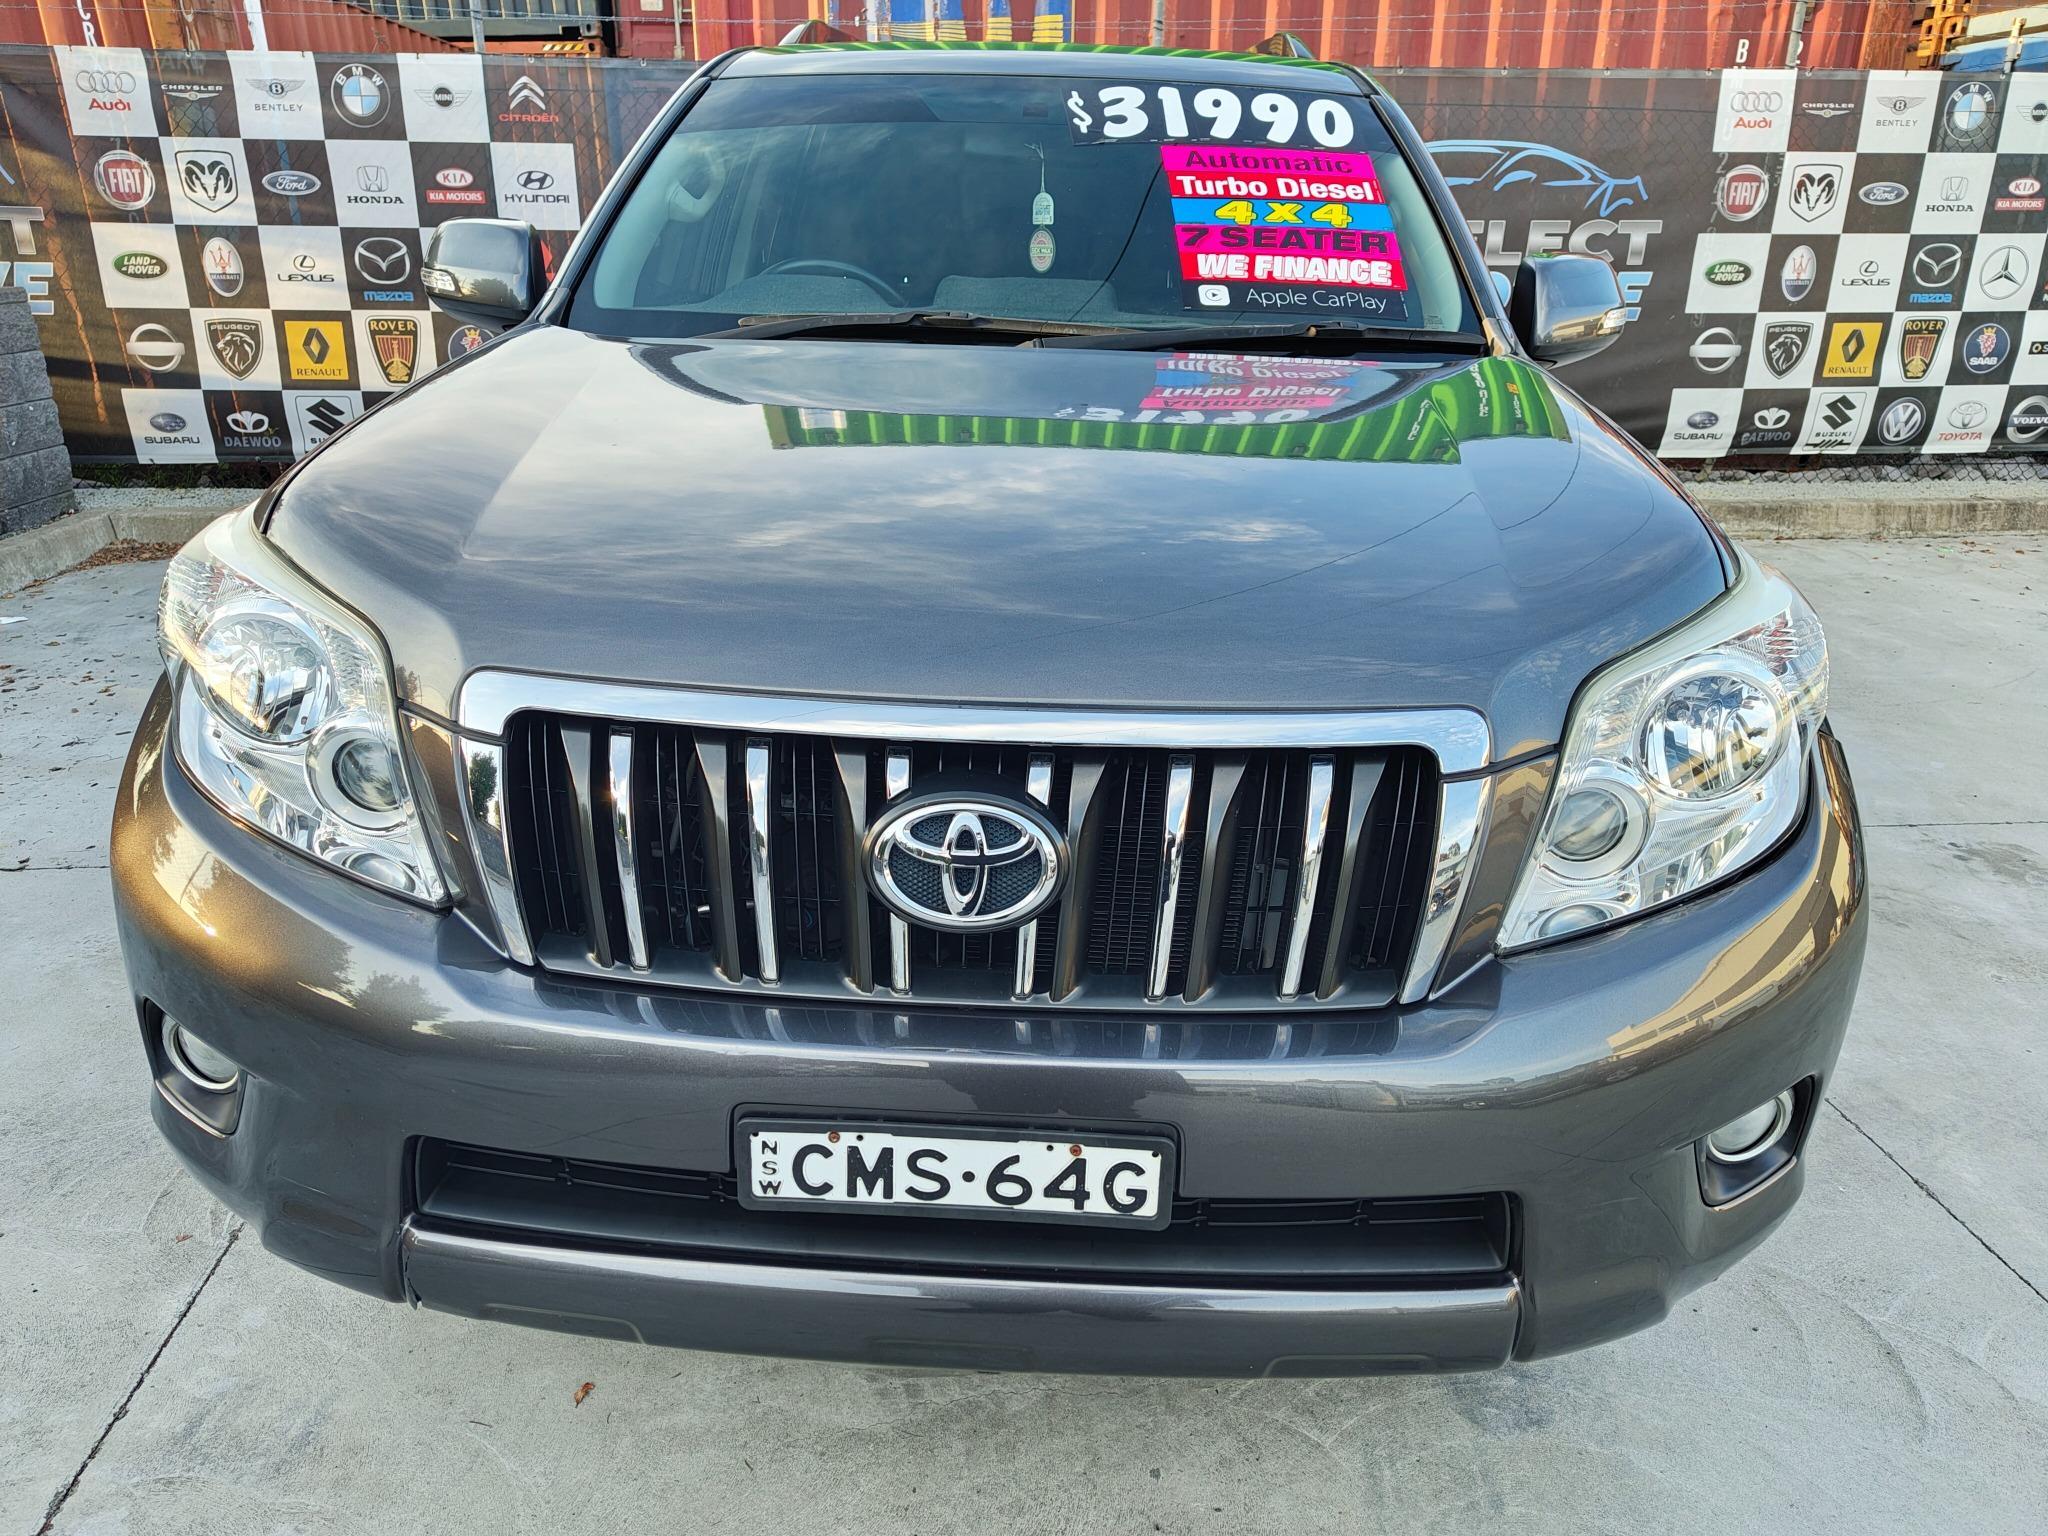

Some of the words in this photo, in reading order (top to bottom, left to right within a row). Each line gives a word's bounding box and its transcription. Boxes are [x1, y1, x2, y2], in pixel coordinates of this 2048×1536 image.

[335, 65, 385, 88] BMW
[1952, 83, 1993, 102] BMW
[88, 98, 131, 111] Audi
[254, 103, 304, 112] BENTLEY
[1066, 85, 1355, 148] $31990
[1733, 116, 1772, 129] Audi
[1875, 119, 1918, 127] BENTLEY
[1185, 151, 1353, 173] Automatic
[108, 168, 141, 193] FIAT
[442, 172, 470, 184] KIA
[275, 178, 307, 191] Ford
[1176, 176, 1268, 197] Turbo
[1278, 178, 1374, 200] Diesel
[2014, 182, 2036, 192] KIA
[429, 192, 447, 201] KIA
[447, 192, 482, 202] MOTORS
[1728, 181, 1759, 206] FIAT
[1868, 189, 1897, 201] Ford
[347, 196, 404, 205] HONDA
[504, 194, 570, 204] HYUNDAI
[1997, 200, 2011, 208] KIA
[2012, 200, 2042, 208] MOTORS
[1926, 204, 1974, 213] HONDA
[1181, 227, 1209, 247] 7
[1220, 227, 1389, 254] SEATER
[123, 255, 150, 265] LAND
[128, 265, 160, 275] ROVER
[1197, 254, 1249, 279] WE
[1254, 255, 1393, 286] FINANCE
[1714, 264, 1738, 273] LAND
[277, 274, 334, 282] LEXUS
[1715, 273, 1745, 282] ROVER
[1246, 288, 1307, 307] Apple
[1312, 290, 1387, 313] CarPlay
[210, 323, 256, 331] PEUGEOT
[370, 320, 416, 331] ROVER
[1904, 320, 1944, 331] ROVER
[1969, 357, 1997, 366] SAAB
[296, 368, 343, 377] RENAULT
[1828, 366, 1868, 375] RENAULT
[144, 436, 200, 445] SUBARU
[1673, 432, 1723, 441] SUBARU
[1741, 431, 1792, 446] DAEWOO
[1938, 432, 1983, 441] TOYOTA
[224, 436, 281, 448] DAEWOO
